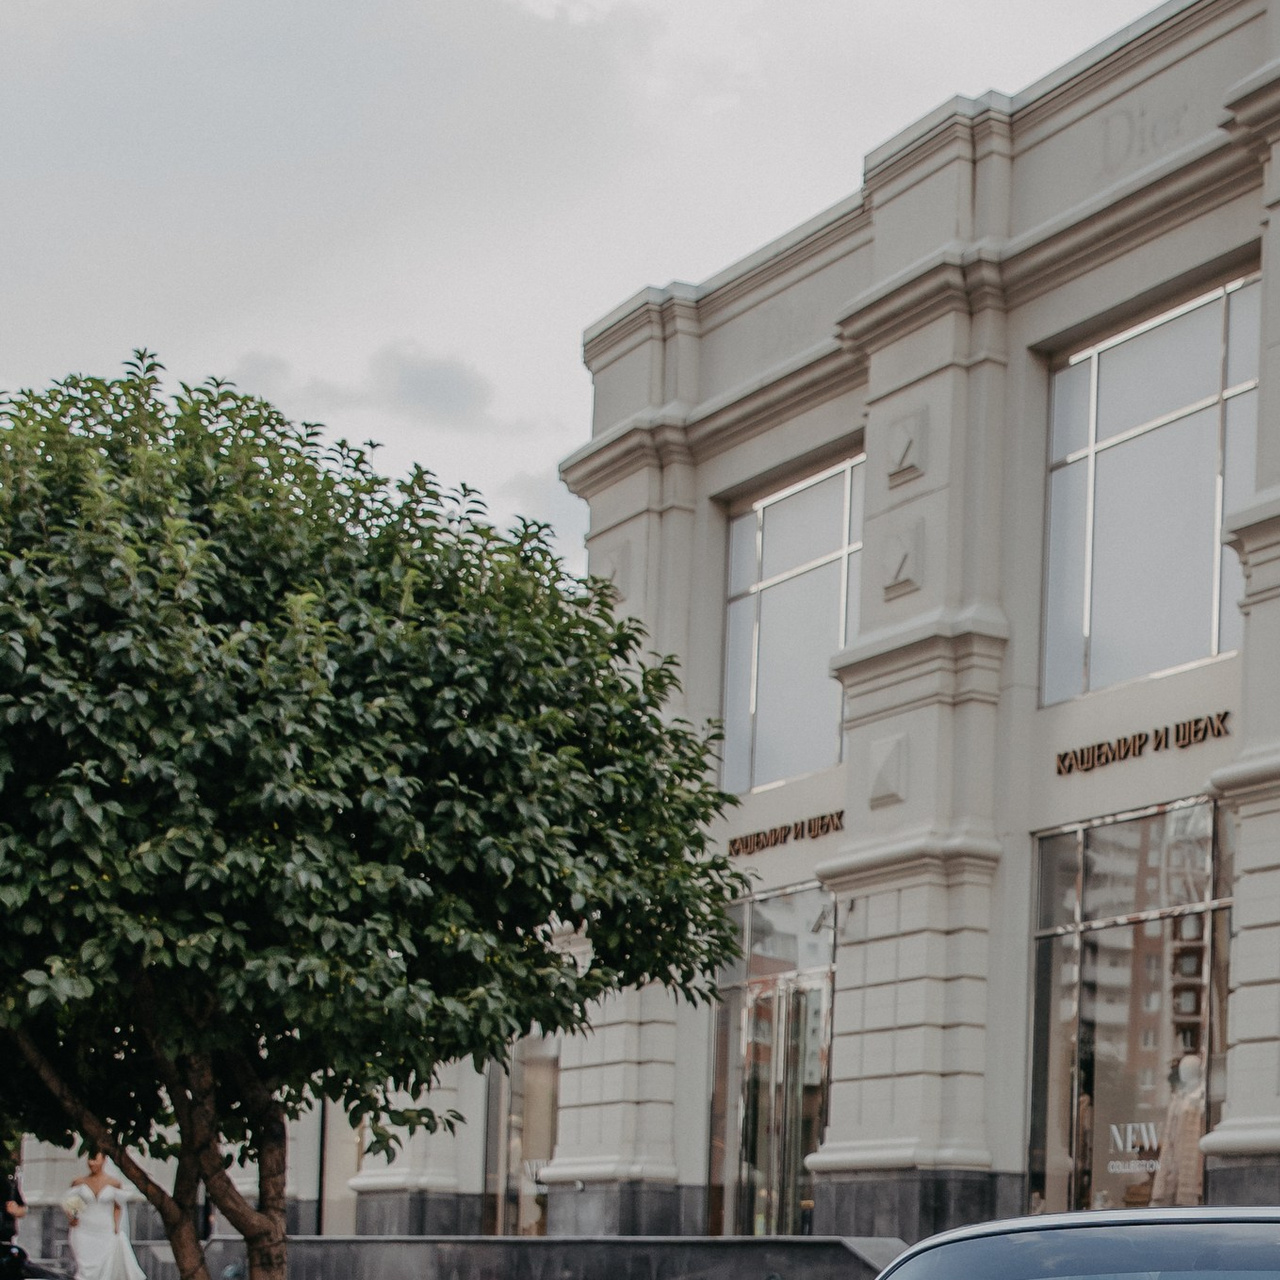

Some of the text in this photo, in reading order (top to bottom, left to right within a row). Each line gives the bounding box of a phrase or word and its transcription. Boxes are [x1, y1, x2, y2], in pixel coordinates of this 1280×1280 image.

[1056, 710, 1232, 776] КАШЕМИР И ШЕЛК
[793, 821, 805, 841] И
[1110, 1122, 1162, 1154] NEW
